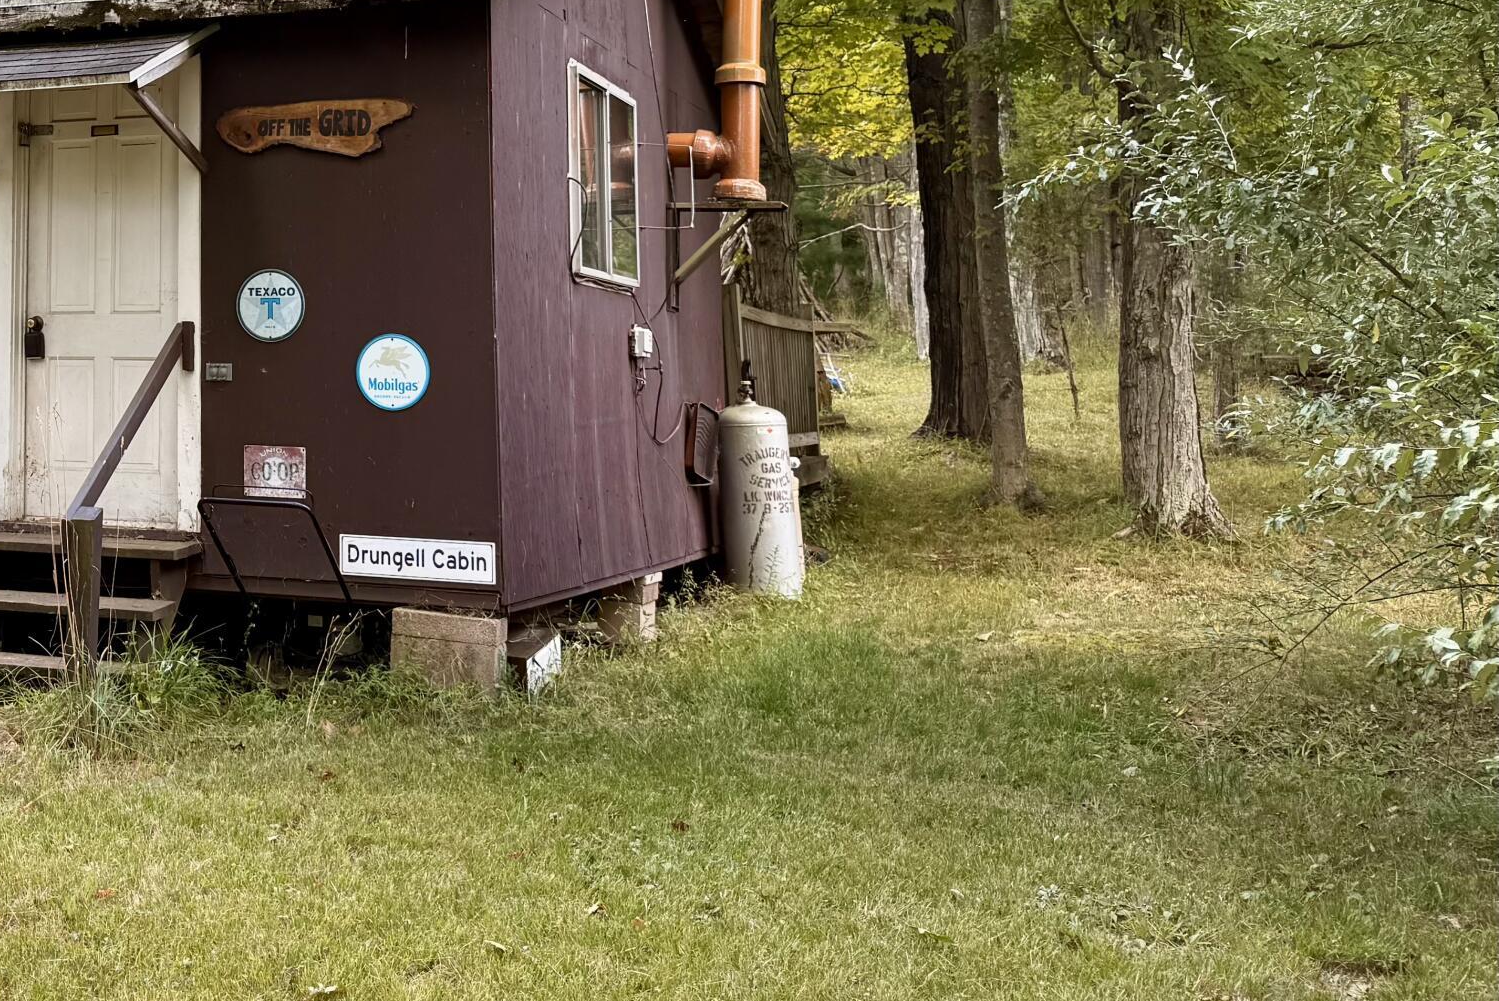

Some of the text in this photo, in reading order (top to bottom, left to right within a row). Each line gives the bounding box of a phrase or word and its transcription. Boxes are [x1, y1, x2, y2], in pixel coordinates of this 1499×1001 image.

[257, 109, 372, 137] OFF THE GRID
[247, 287, 296, 297] TEXACO
[260, 297, 281, 320] T
[368, 377, 418, 394] Mobilgas
[260, 447, 288, 457] UNION
[761, 462, 782, 474] GAS
[347, 543, 487, 572] Drungell Cabin
